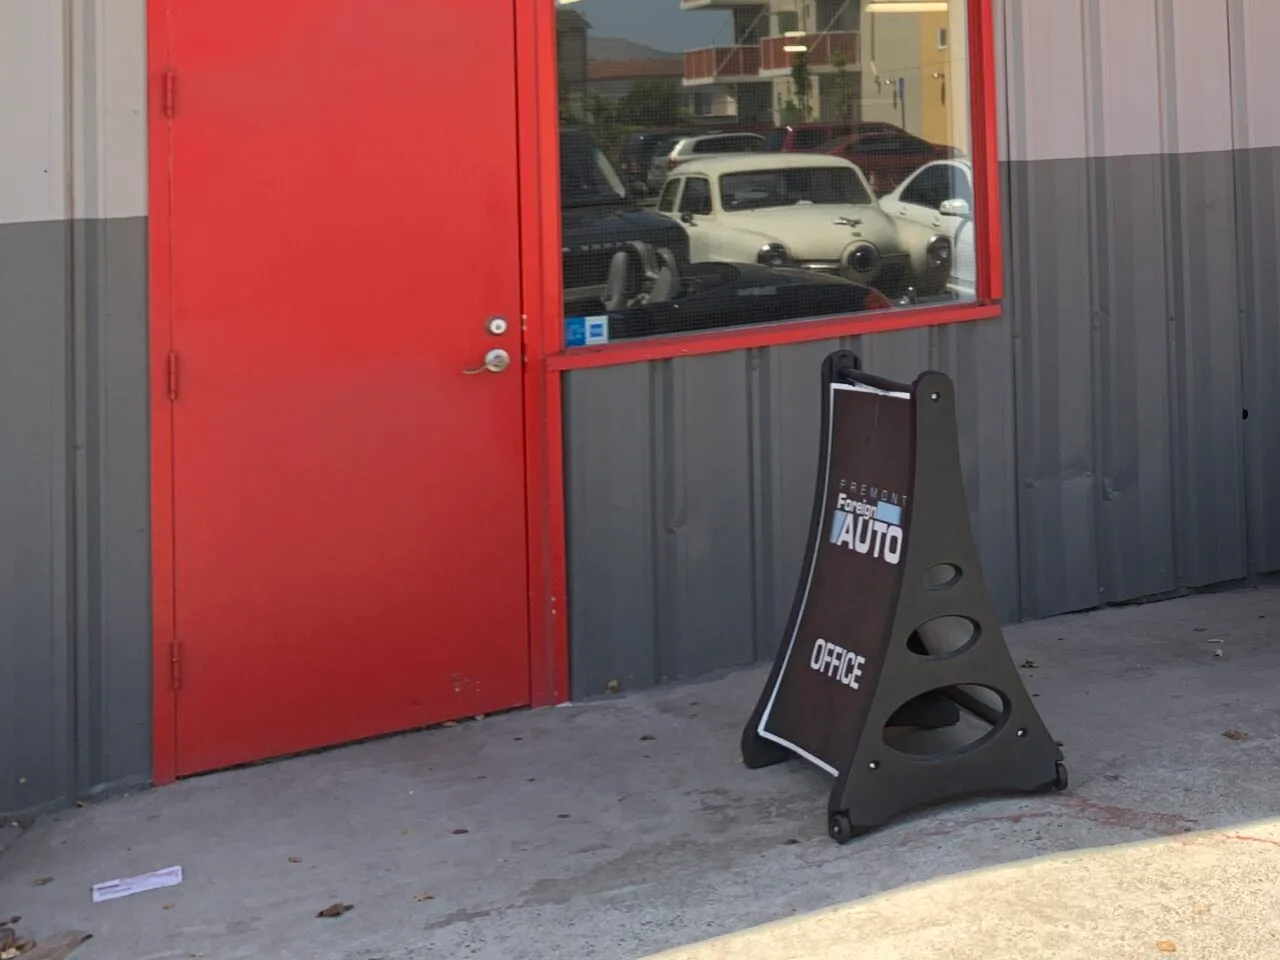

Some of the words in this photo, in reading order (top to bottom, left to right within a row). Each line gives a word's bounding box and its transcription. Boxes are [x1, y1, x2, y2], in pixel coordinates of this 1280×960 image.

[837, 492, 877, 520] Foreign
[840, 479, 907, 507] FREMONT
[836, 513, 903, 565] AUTO
[811, 638, 866, 690] OFFICE
